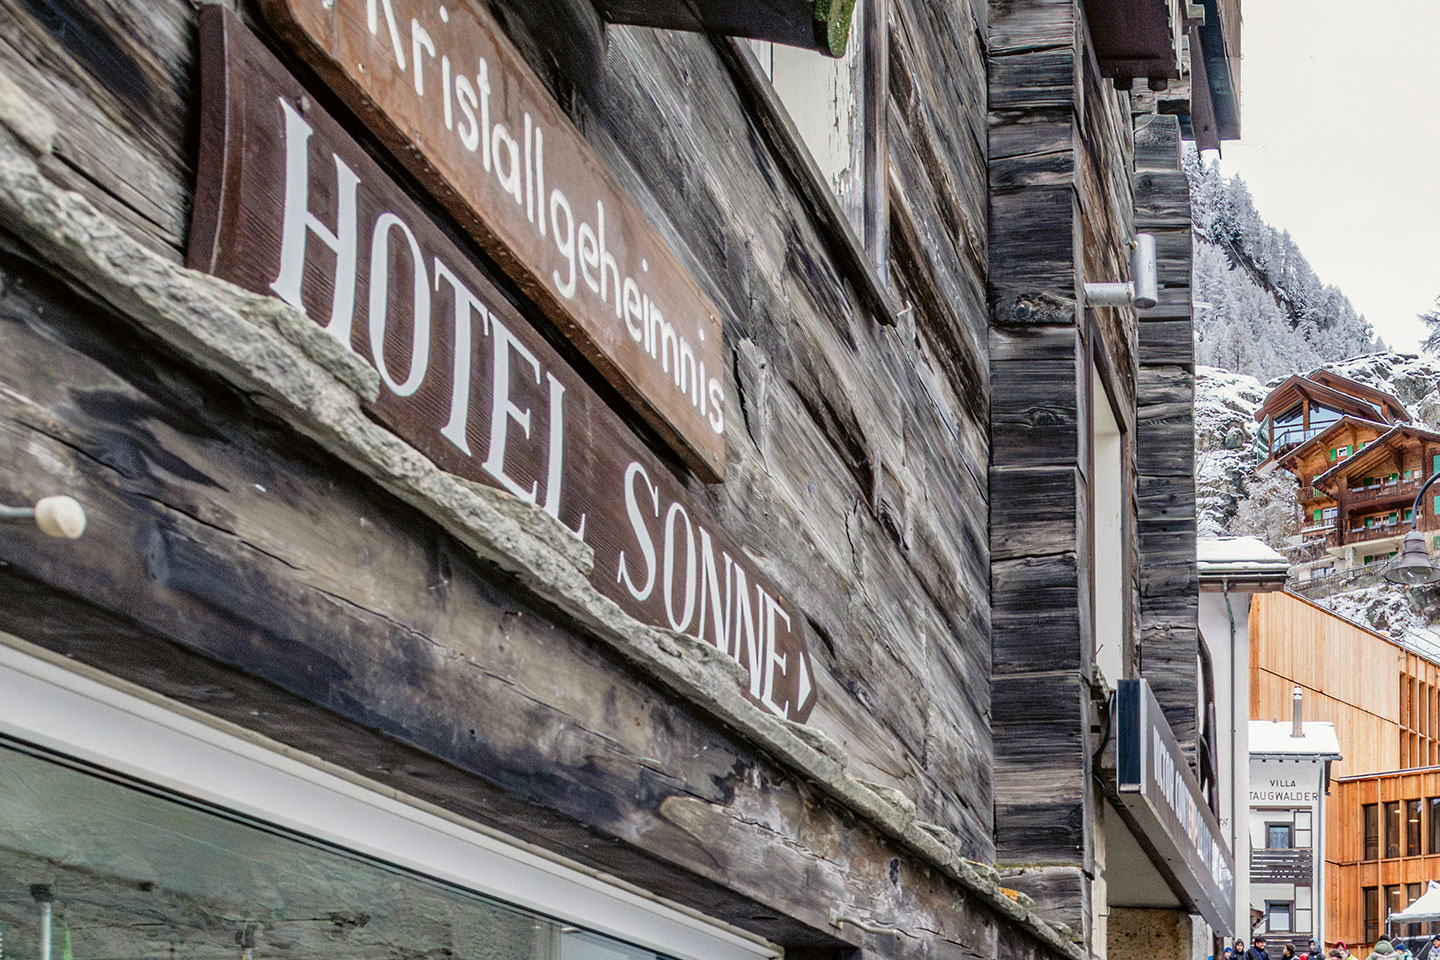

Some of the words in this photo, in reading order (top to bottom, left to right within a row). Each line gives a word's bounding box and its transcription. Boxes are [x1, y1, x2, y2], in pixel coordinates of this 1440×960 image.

[270, 97, 586, 541] HOTEL
[617, 461, 794, 719] SONNE
[1249, 791, 1319, 801] TAUGWALDER
